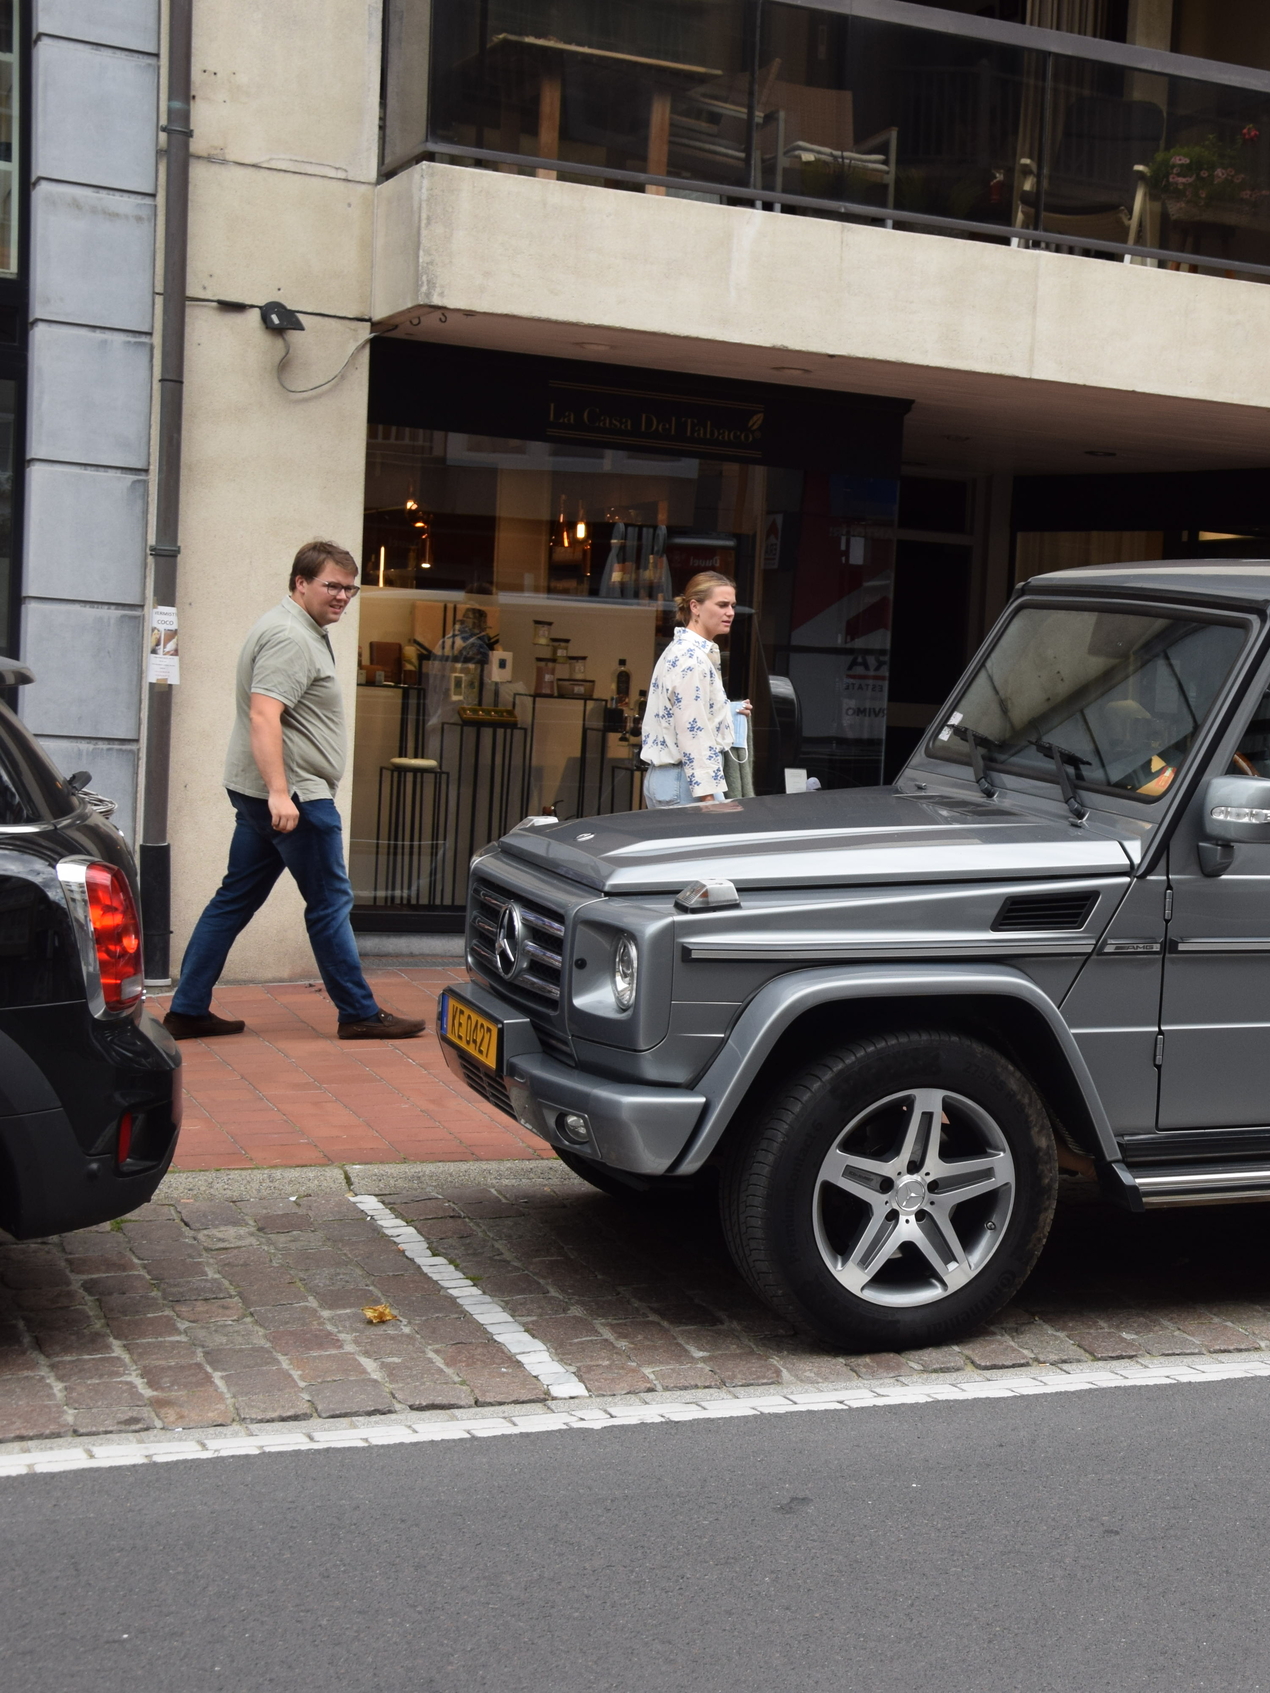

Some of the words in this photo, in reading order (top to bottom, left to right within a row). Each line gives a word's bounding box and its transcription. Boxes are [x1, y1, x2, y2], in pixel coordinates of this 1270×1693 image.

[548, 403, 575, 424] La
[582, 406, 632, 431] Casa
[640, 413, 677, 435] Del
[682, 417, 753, 443] Tabaco
[451, 1003, 465, 1041] KE
[466, 1014, 493, 1059] 0427
